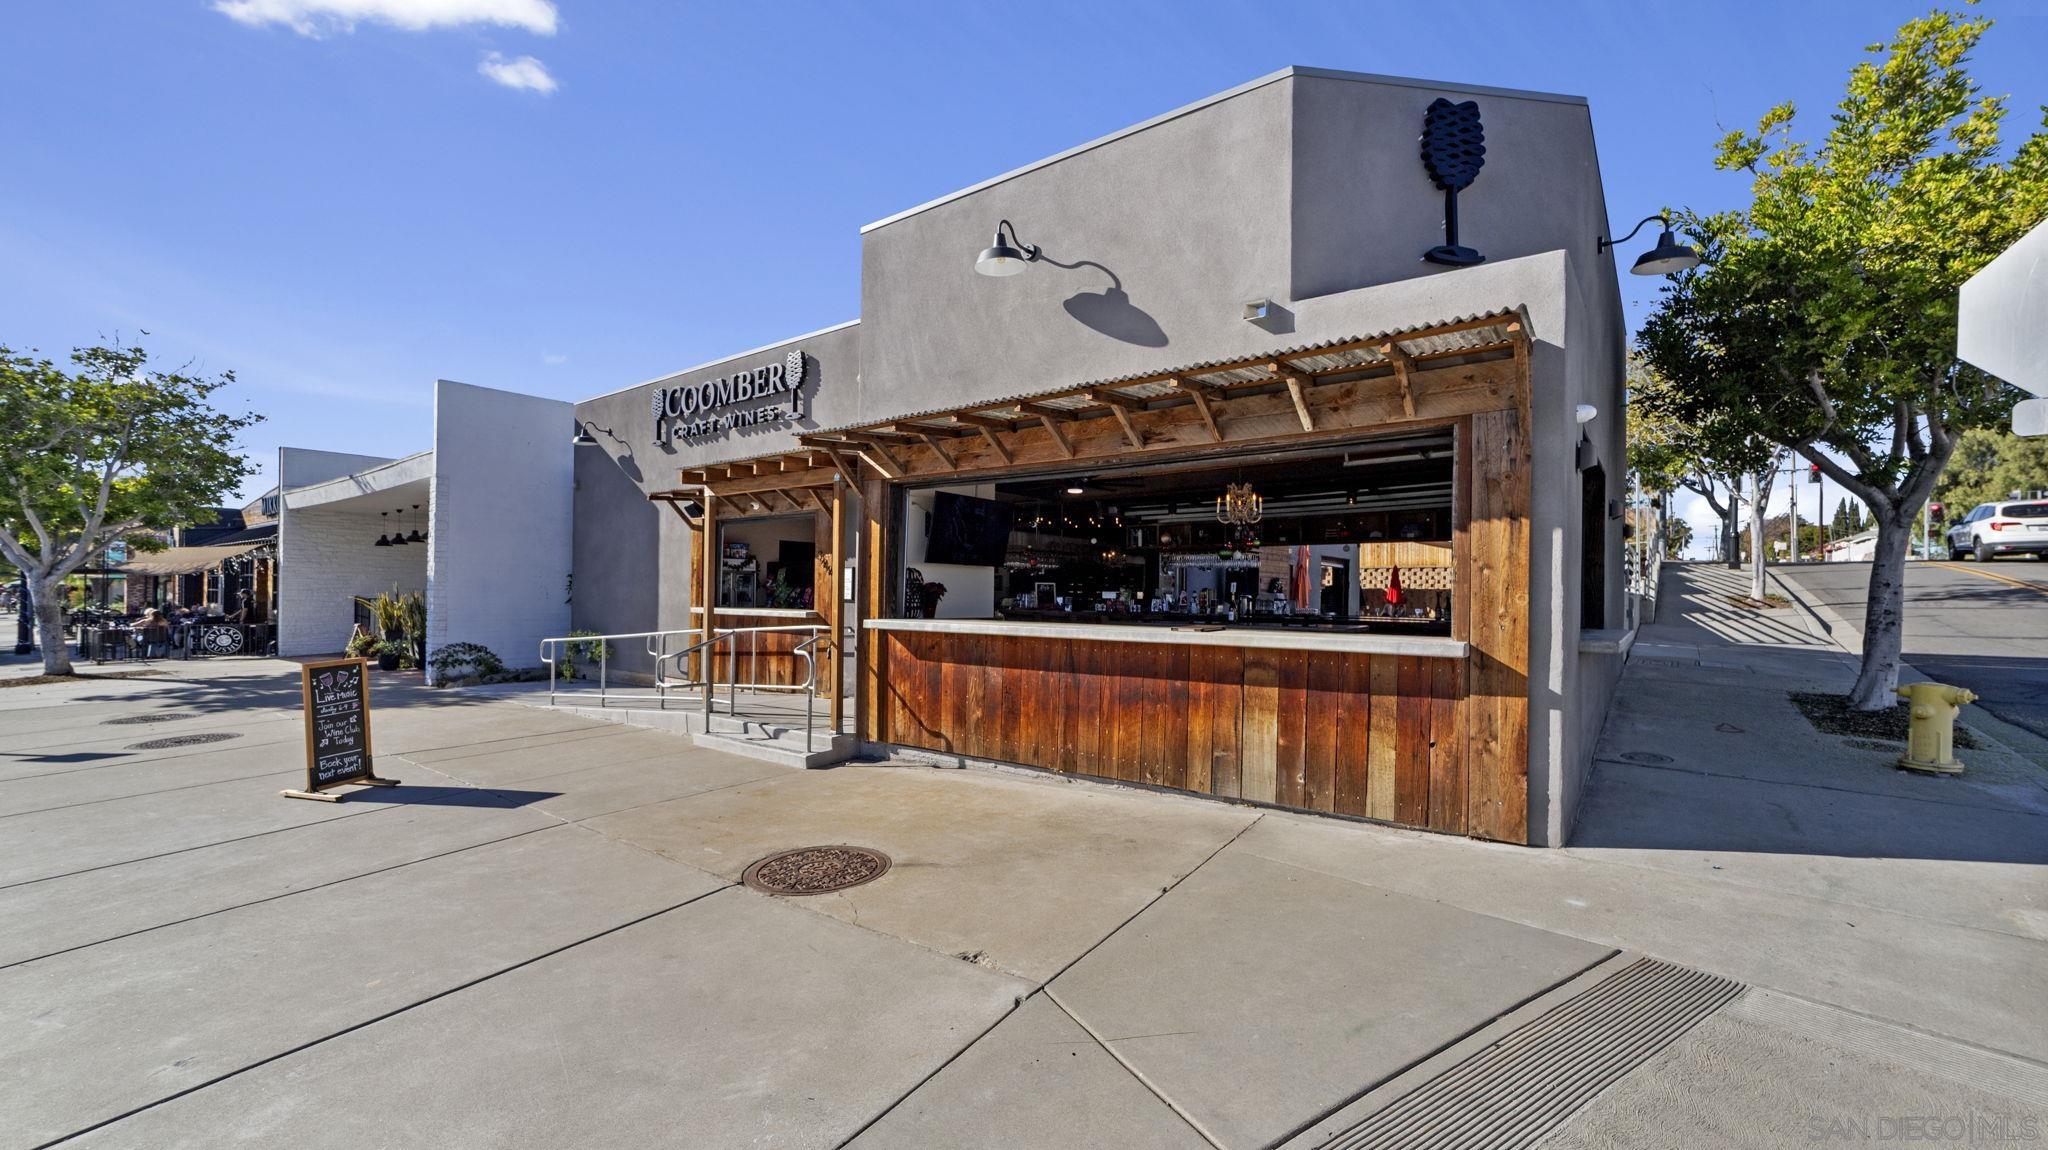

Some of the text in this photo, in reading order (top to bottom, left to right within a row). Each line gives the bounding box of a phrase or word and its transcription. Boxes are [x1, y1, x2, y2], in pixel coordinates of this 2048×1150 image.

[665, 363, 785, 417] COOMBER
[672, 406, 780, 439] CRAFT WINES
[261, 495, 280, 515] MIKK
[207, 628, 241, 641] MIKKO
[208, 642, 239, 653] SUSHI
[318, 720, 348, 731] Join our
[324, 725, 360, 738] Wine Club
[333, 735, 354, 746] Today
[320, 754, 359, 770] Book your
[318, 769, 335, 780] next
